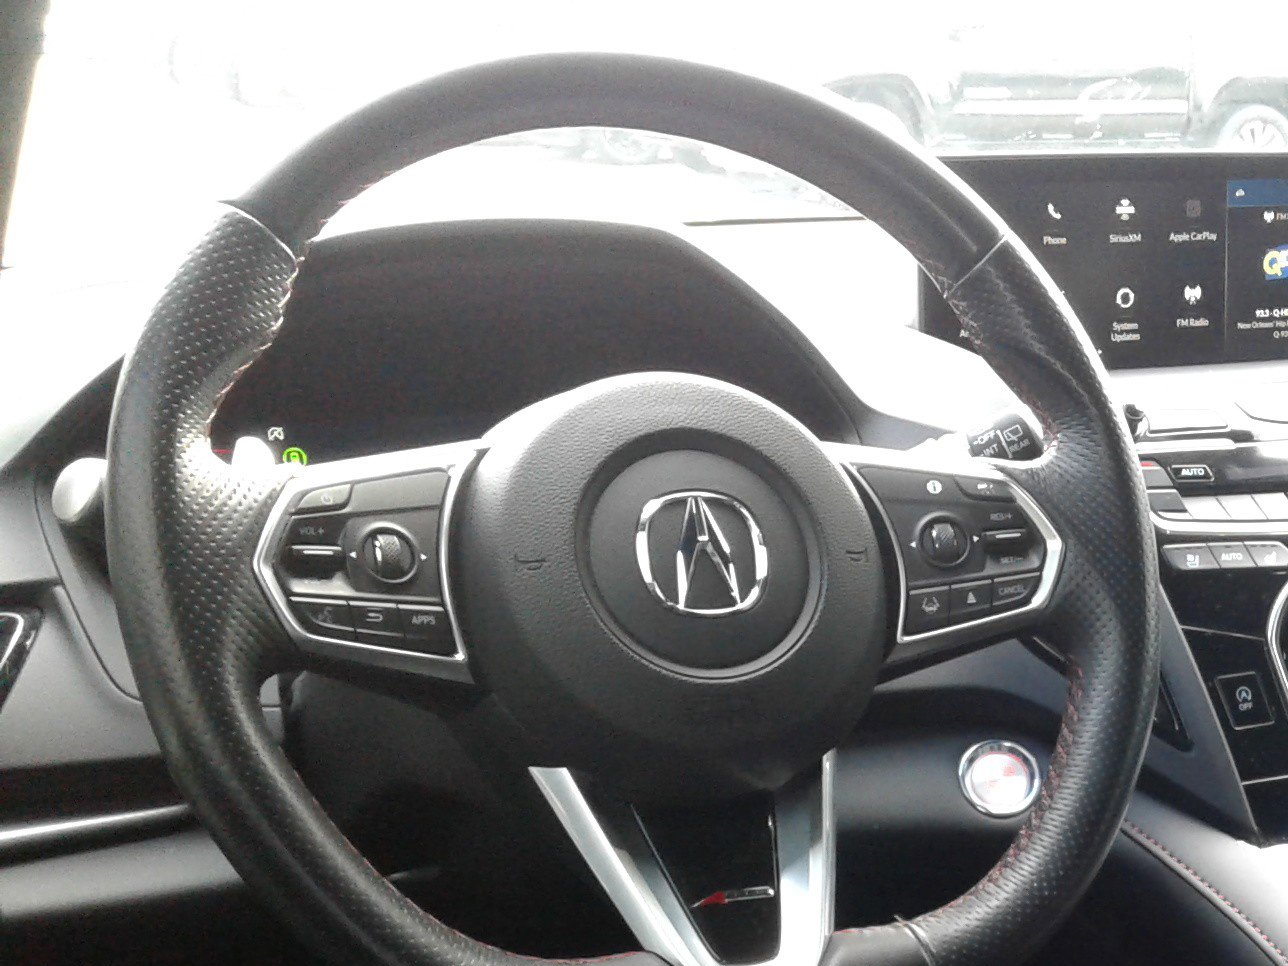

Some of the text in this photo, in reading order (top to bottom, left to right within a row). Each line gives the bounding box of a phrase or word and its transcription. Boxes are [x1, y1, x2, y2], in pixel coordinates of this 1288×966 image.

[1043, 235, 1067, 245] Phone
[1109, 232, 1142, 243] SiriusXM
[1169, 231, 1218, 243] Apple CarPlay
[1112, 322, 1139, 332] System
[1176, 317, 1210, 328] FM Radio
[1110, 332, 1141, 342] Updates
[1181, 468, 1205, 476] AUTO
[1221, 552, 1243, 561] AUTO
[411, 614, 436, 625] APPS
